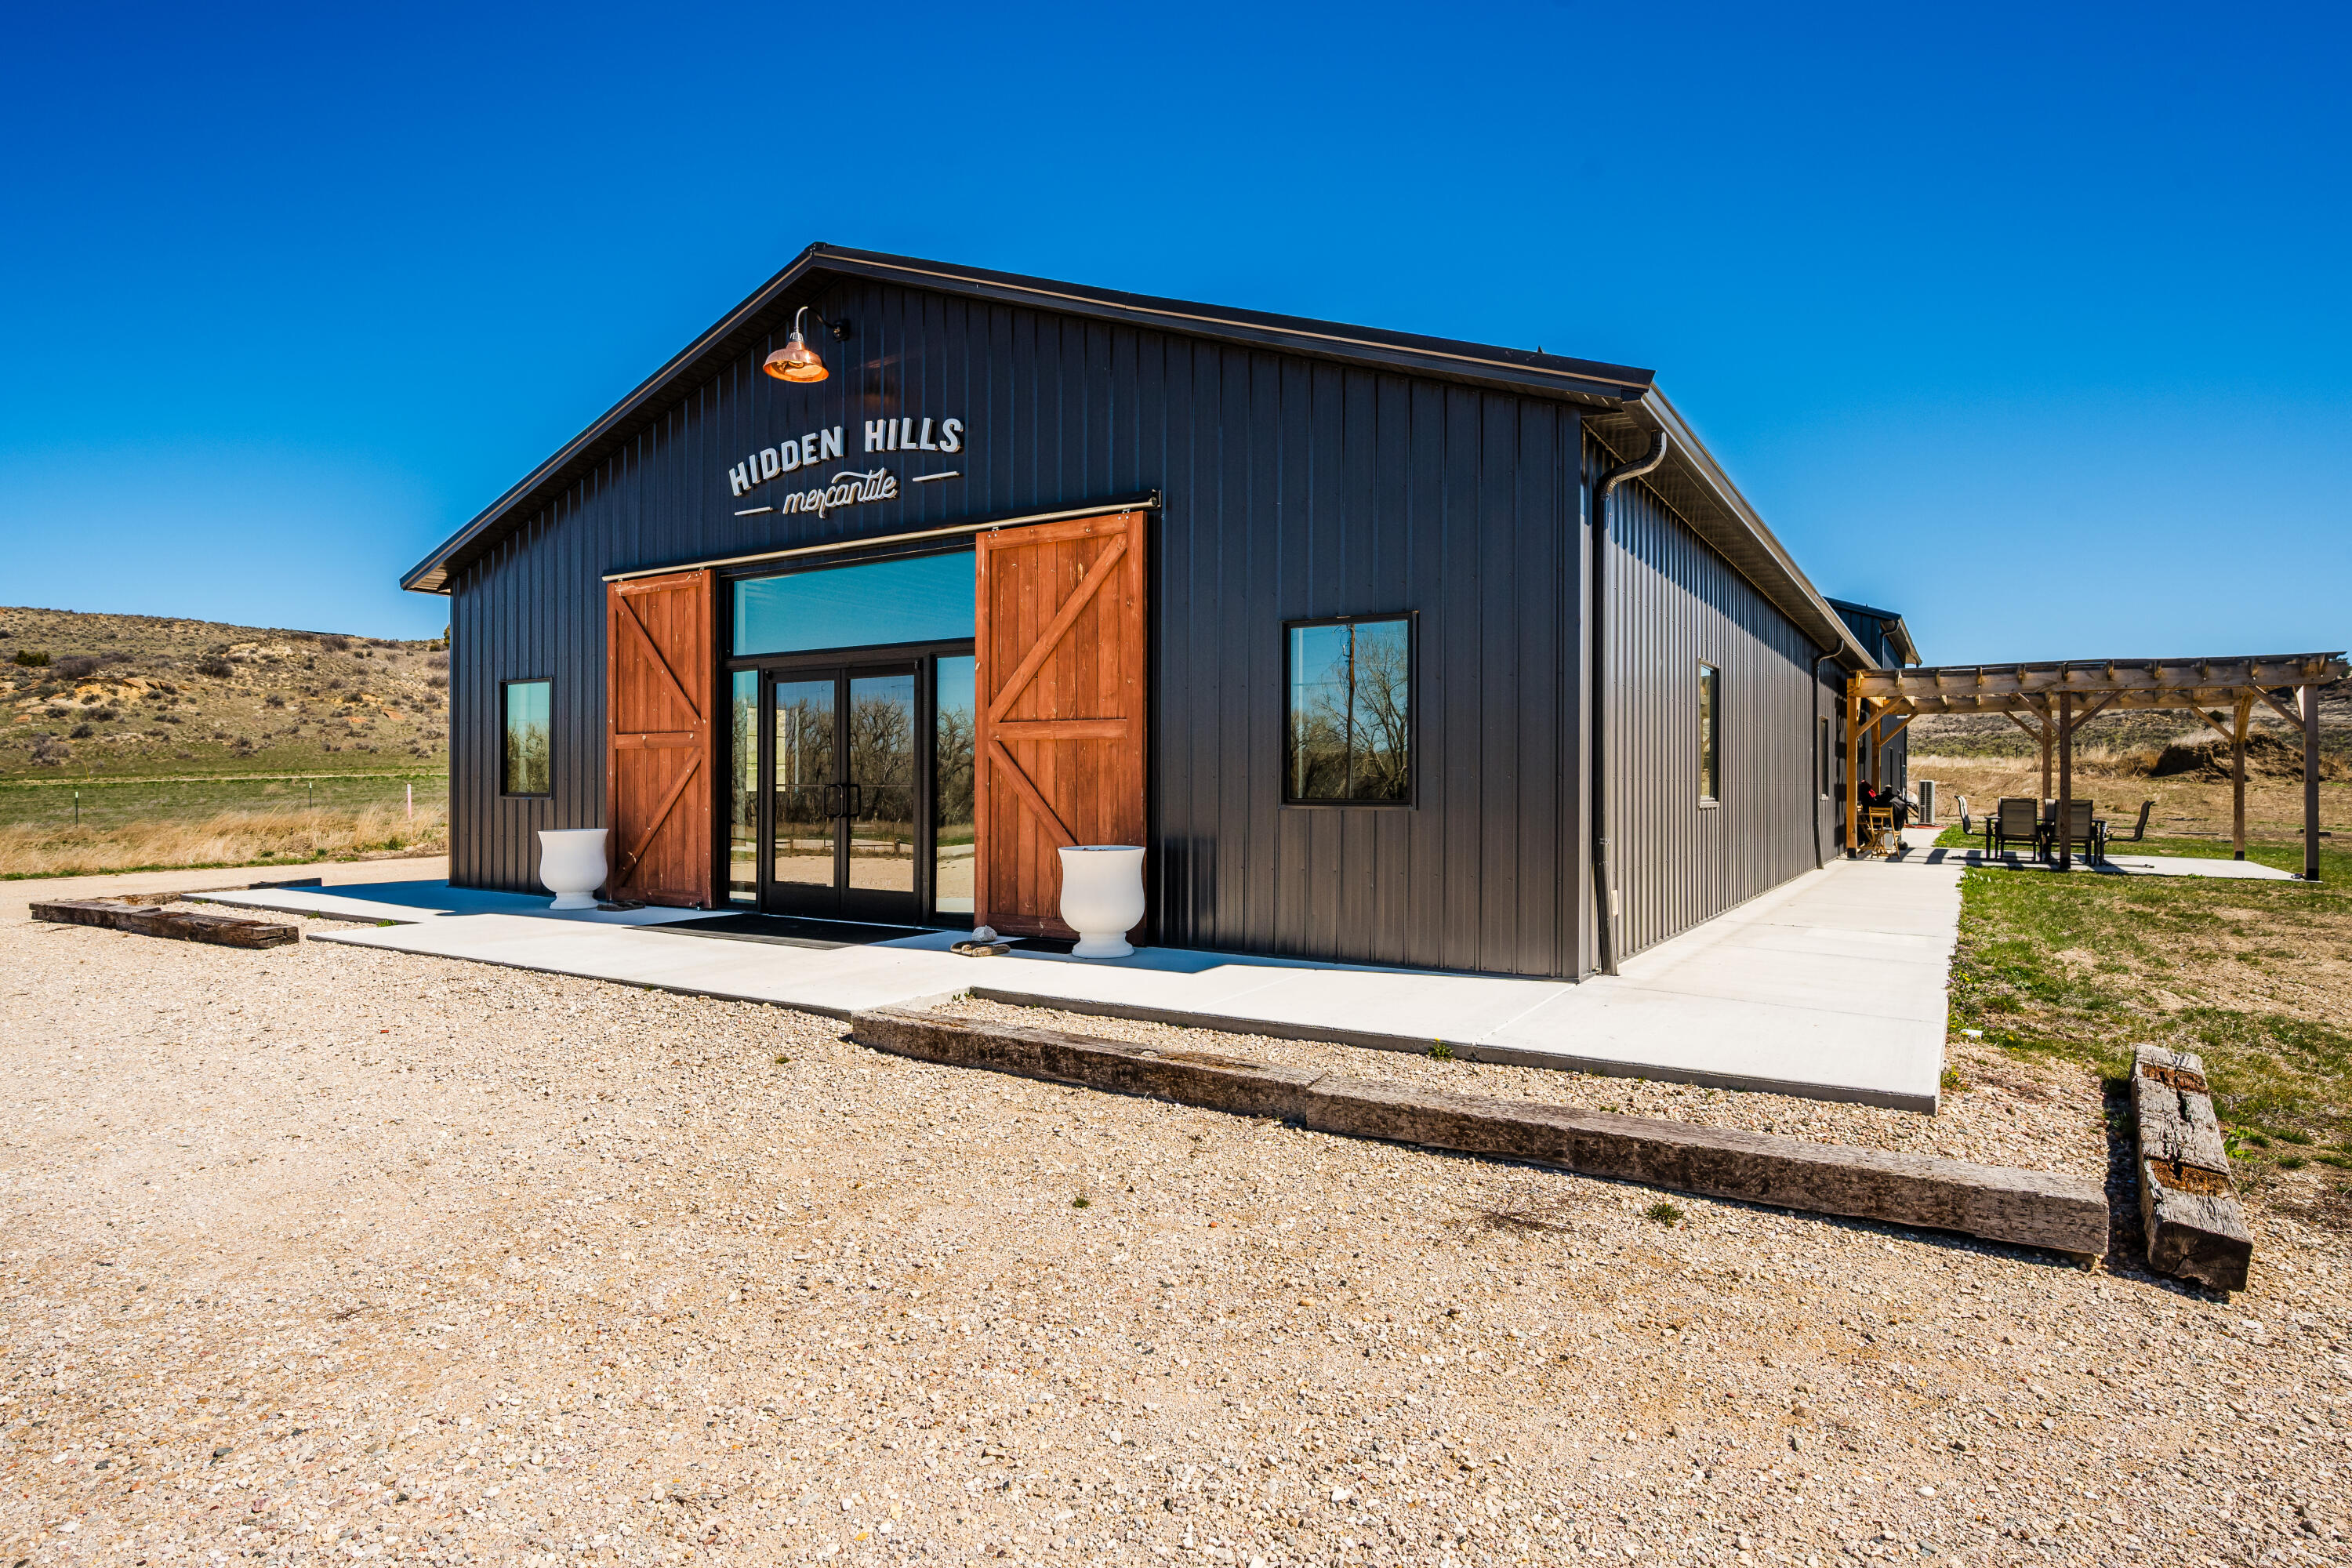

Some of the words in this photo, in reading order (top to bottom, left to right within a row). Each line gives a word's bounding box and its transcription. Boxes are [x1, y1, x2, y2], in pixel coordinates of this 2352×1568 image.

[728, 426, 844, 496] HIDDEN
[865, 417, 964, 453] HILLS
[782, 467, 897, 519] mercantile
